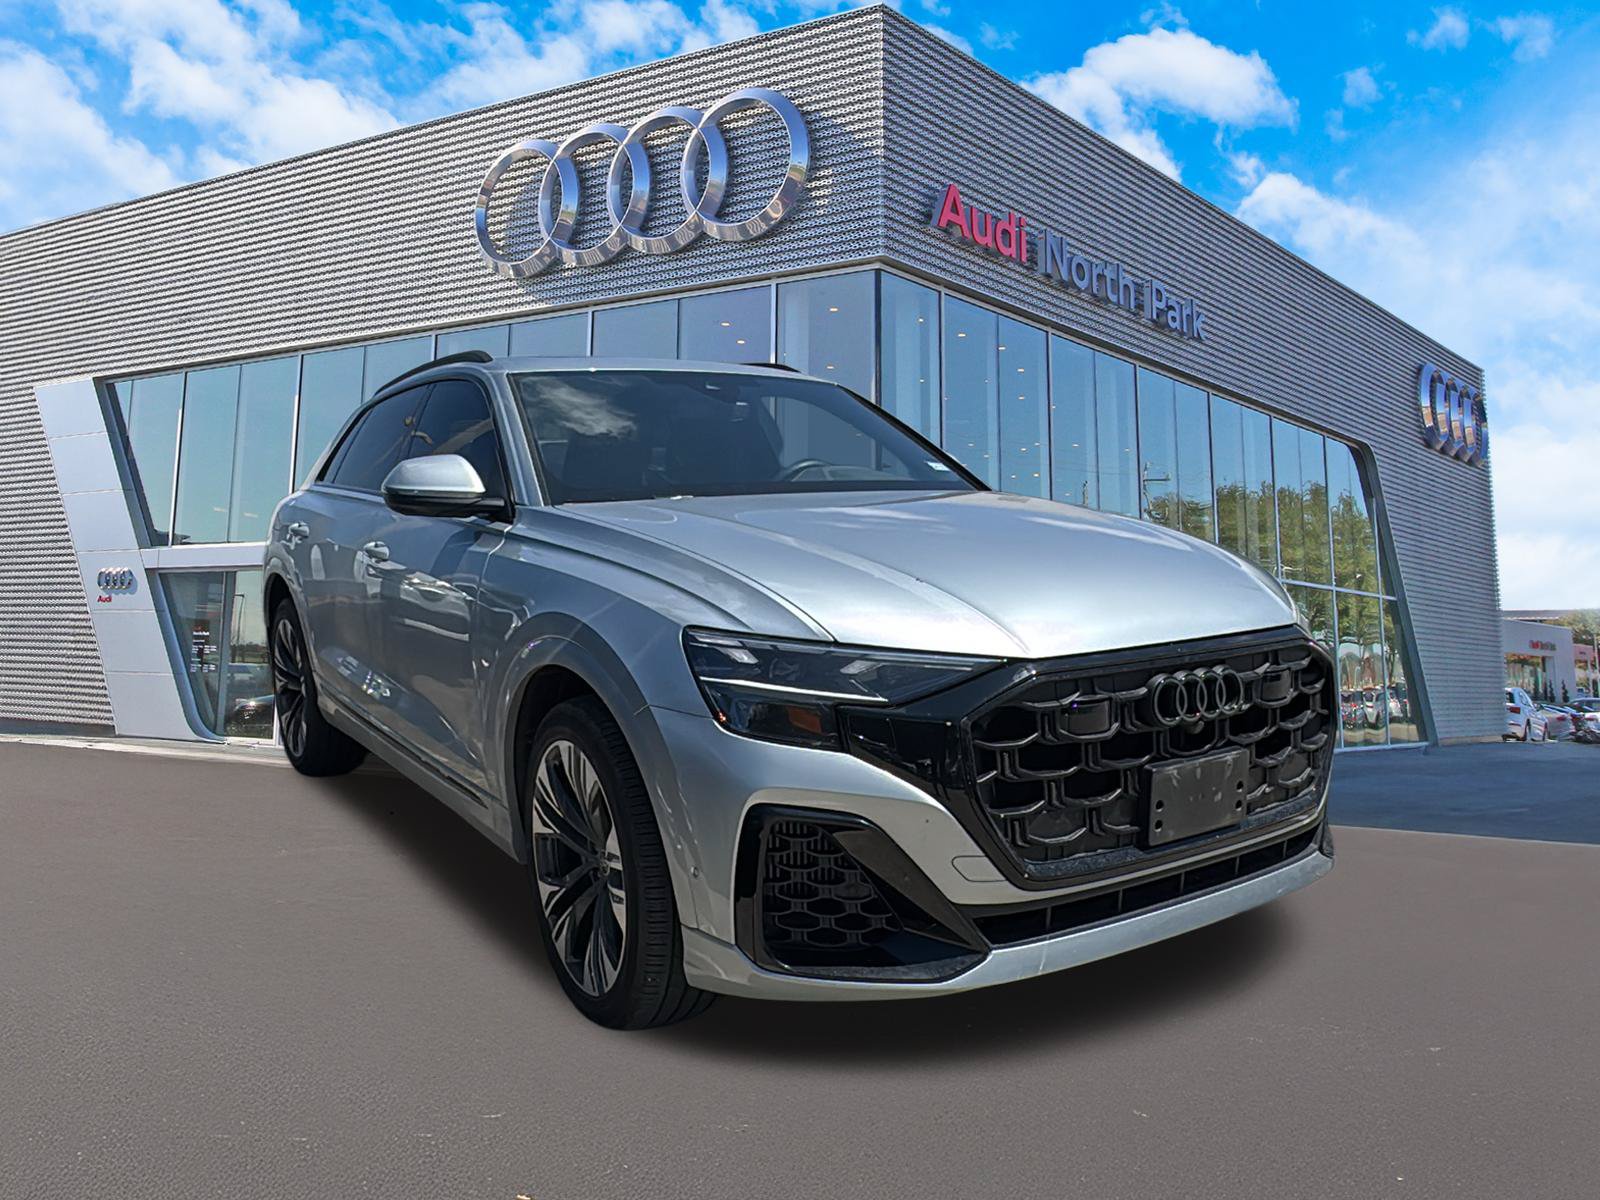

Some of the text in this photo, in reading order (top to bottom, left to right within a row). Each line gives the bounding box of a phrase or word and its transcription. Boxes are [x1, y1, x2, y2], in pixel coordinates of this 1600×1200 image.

[931, 183, 1206, 341] Audi North Park
[97, 595, 112, 603] Audi
